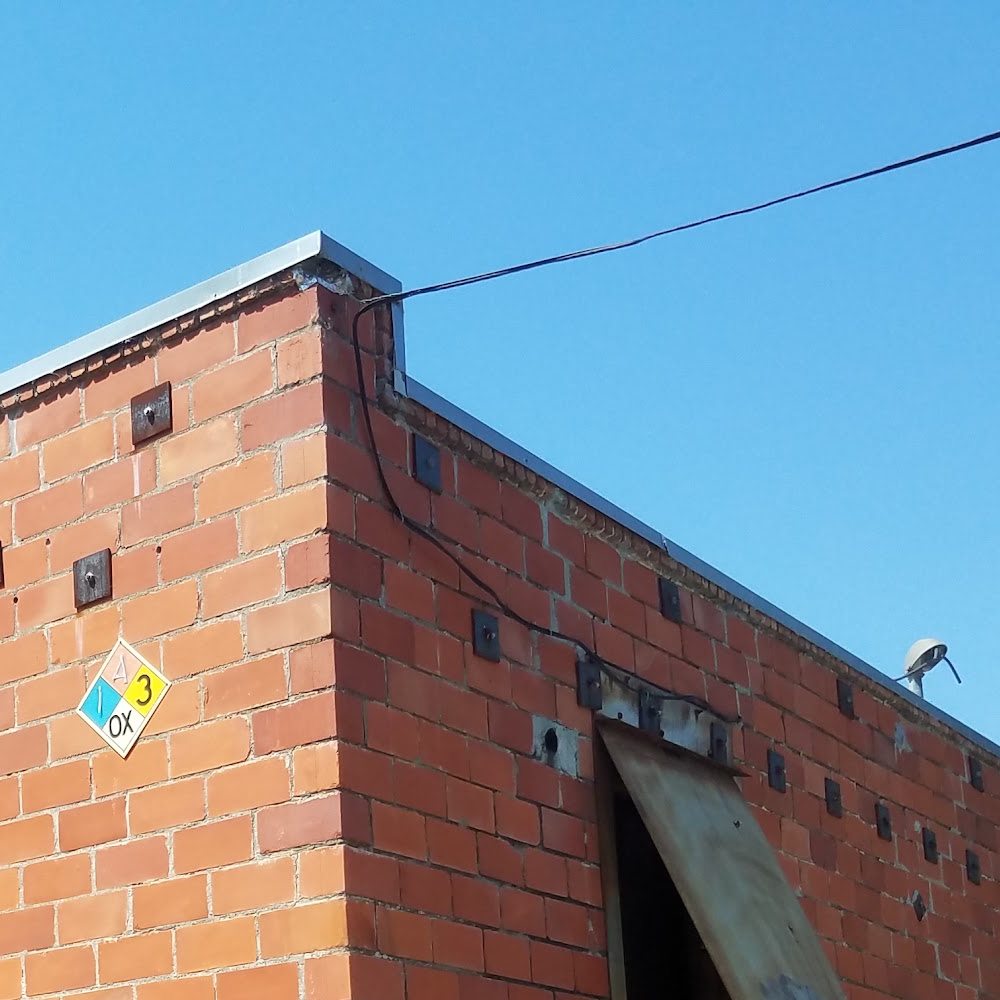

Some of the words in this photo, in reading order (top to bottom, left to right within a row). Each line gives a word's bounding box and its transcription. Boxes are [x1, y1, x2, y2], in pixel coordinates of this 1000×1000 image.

[96, 685, 103, 717] 1
[136, 674, 152, 706] 3
[109, 709, 134, 738] OX
